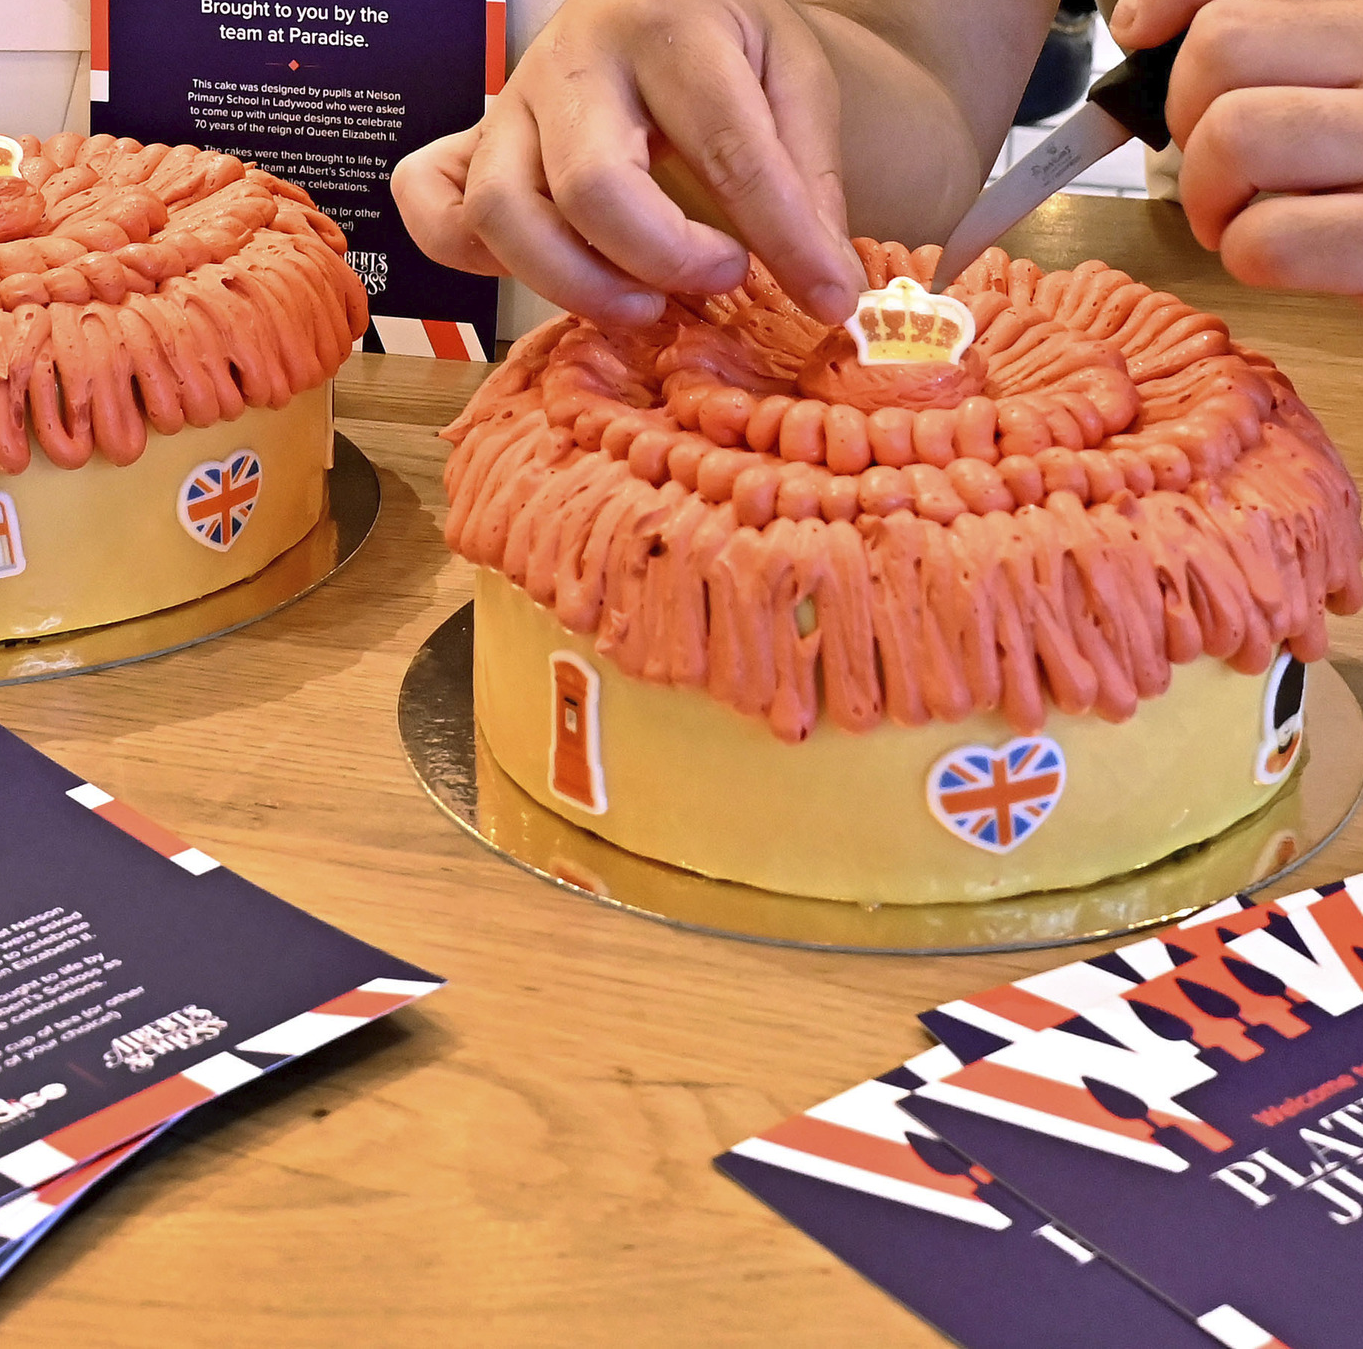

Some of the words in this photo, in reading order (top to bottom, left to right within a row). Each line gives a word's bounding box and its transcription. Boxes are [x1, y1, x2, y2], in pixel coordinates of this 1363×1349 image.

[273, 2, 292, 18] to
[296, 5, 329, 23] you
[334, 4, 356, 26] by
[359, 6, 389, 24] the
[218, 23, 262, 41] team
[267, 27, 285, 43] at
[289, 26, 369, 48] Paradise.
[1252, 1074, 1356, 1127] Welcome
